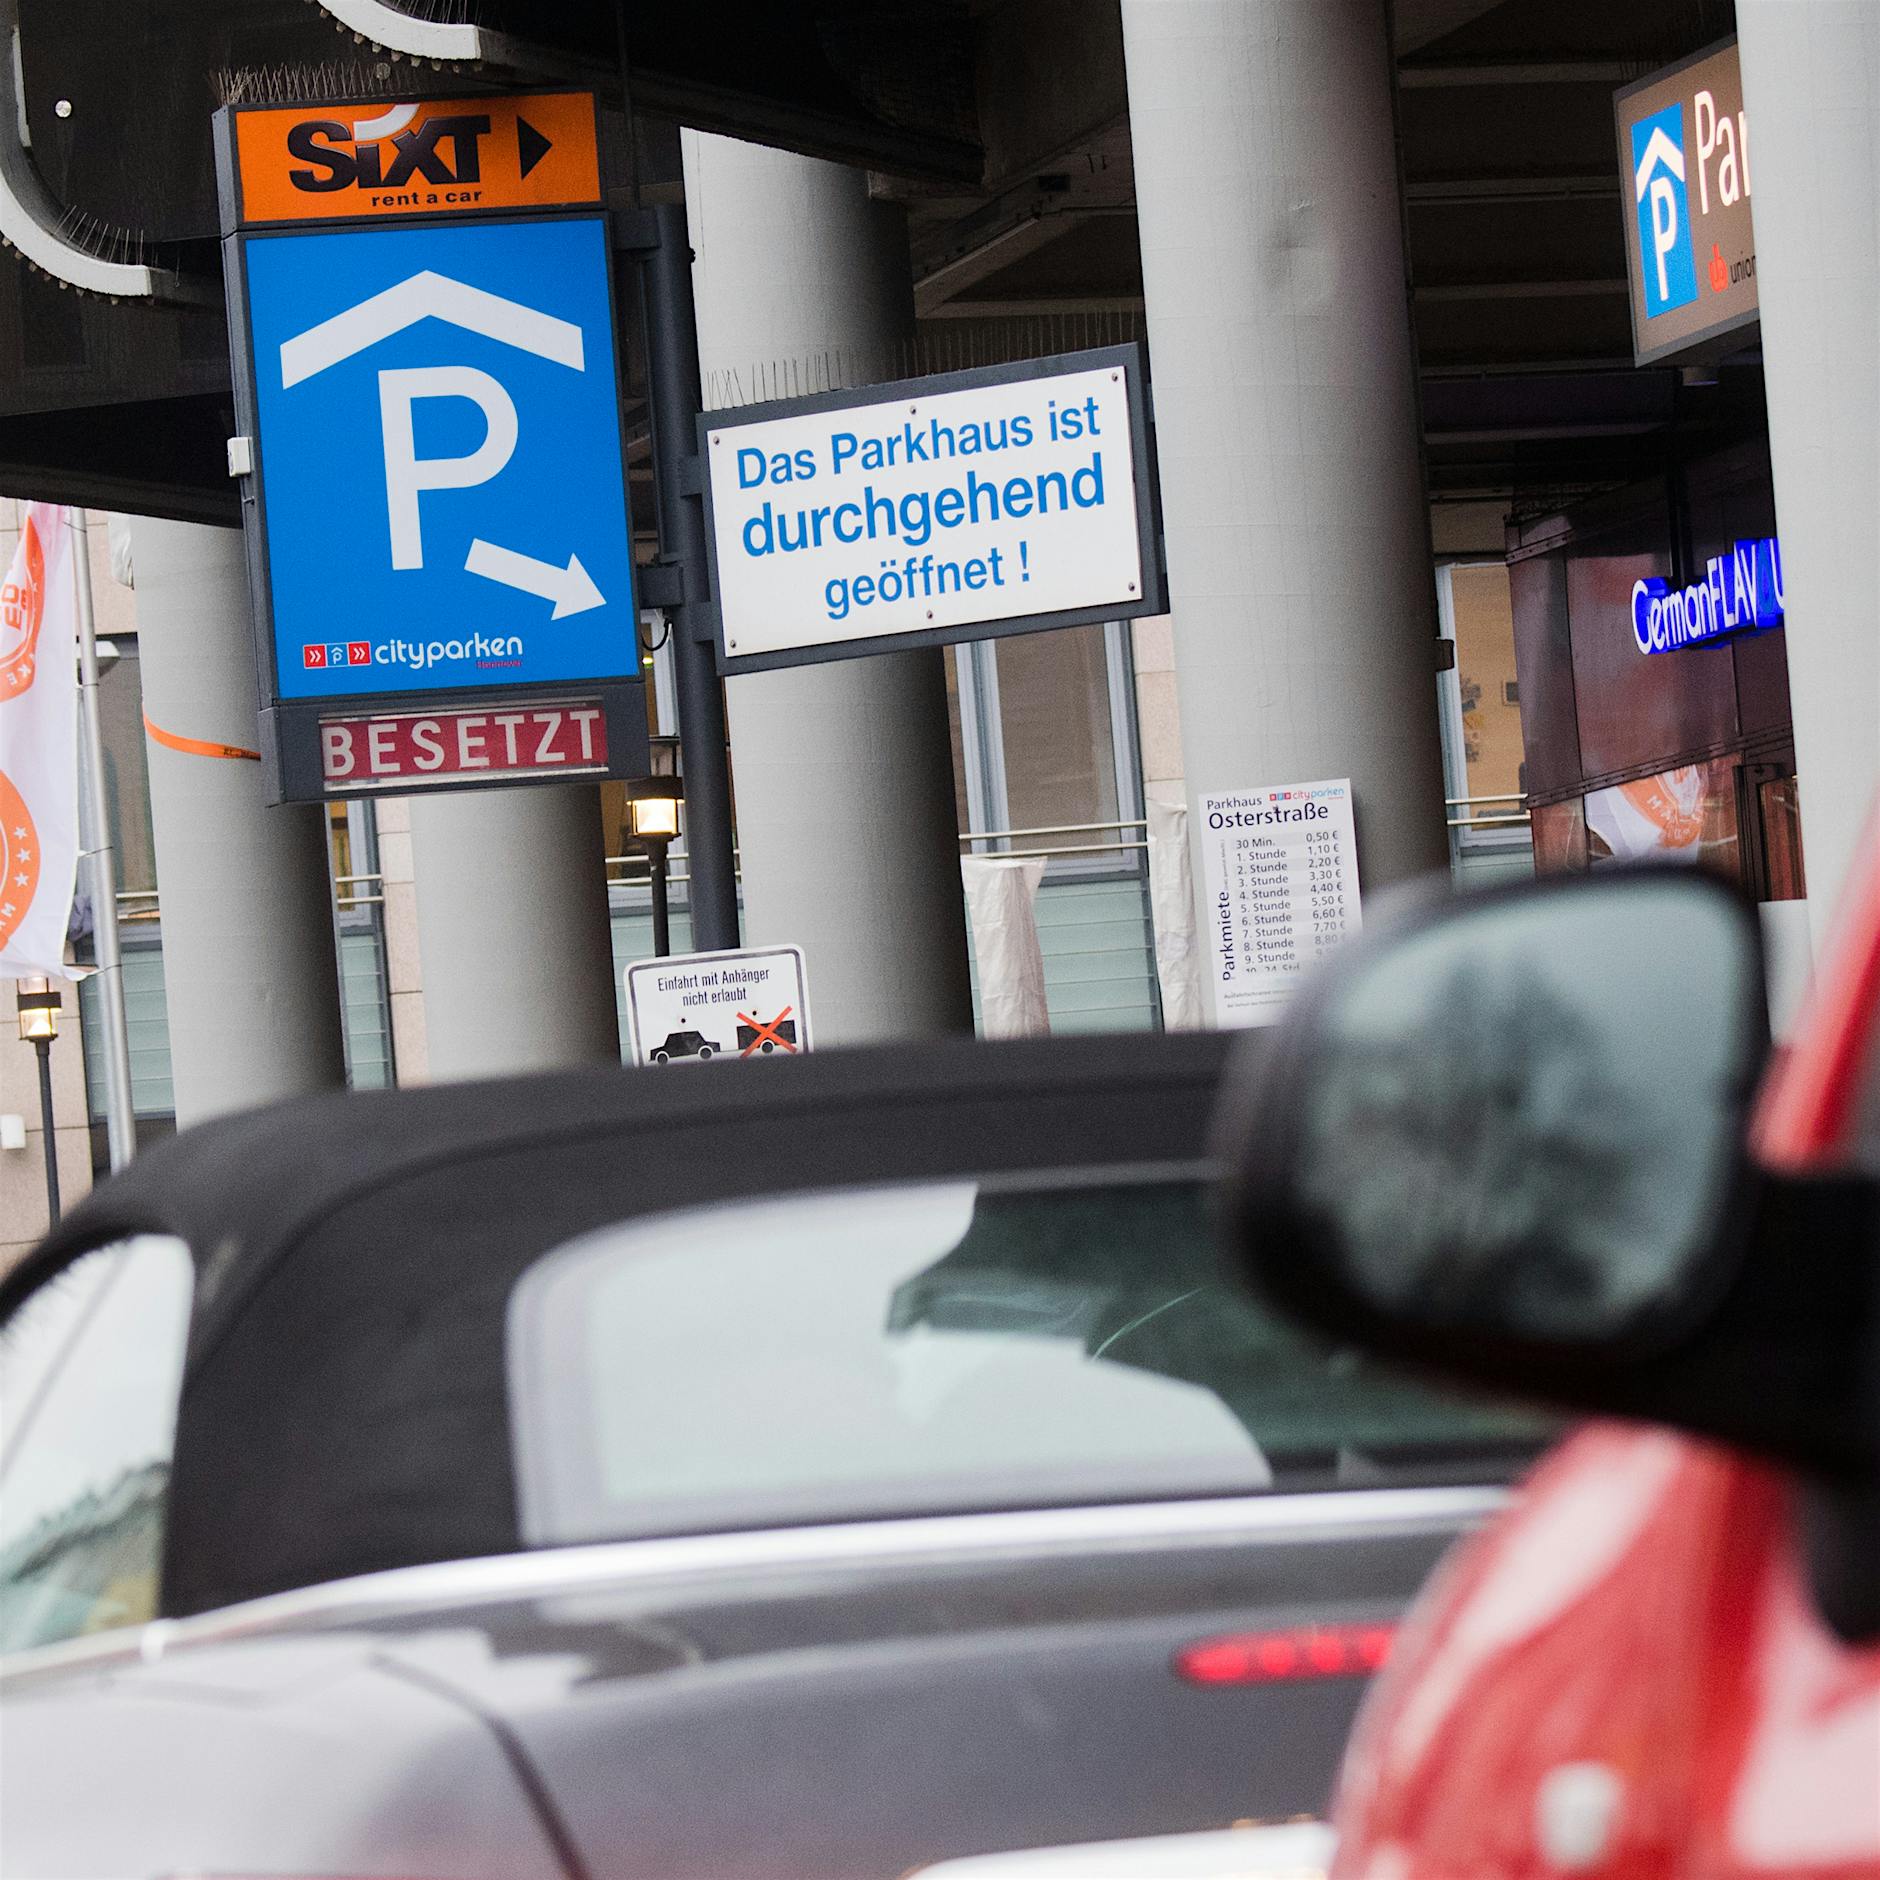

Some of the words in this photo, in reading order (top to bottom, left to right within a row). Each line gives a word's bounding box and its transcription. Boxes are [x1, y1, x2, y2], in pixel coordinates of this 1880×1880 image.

[372, 192, 419, 206] rent
[427, 194, 438, 204] a
[445, 190, 482, 203] car
[736, 447, 816, 489] Das
[831, 414, 1033, 475] Parkhaus
[1048, 396, 1101, 442] ist
[378, 366, 518, 570] P
[742, 451, 1105, 557] durchgehend
[824, 547, 1005, 620] geöffnet
[1019, 541, 1030, 582] !
[375, 632, 523, 670] cityparken
[321, 710, 600, 777] BESETZT
[1207, 796, 1262, 810] Parkhaus
[1209, 802, 1328, 829] Osterstraße
[1236, 840, 1248, 849] 30
[1252, 837, 1275, 848] Min.
[1306, 832, 1329, 843] 0,50
[1249, 849, 1286, 861] Stunde
[1308, 844, 1330, 856] 1,10
[1250, 862, 1287, 874] Stunde
[1308, 857, 1331, 868] 2,20
[1251, 874, 1288, 886] Stunde
[1310, 870, 1332, 882] 3,30
[1252, 888, 1290, 899] Stunde
[1310, 883, 1333, 894] 4,40
[1253, 900, 1291, 912] Stunde
[1312, 896, 1334, 906] 5,50
[1254, 913, 1292, 925] Stunde
[1312, 908, 1336, 920] 6,60
[1218, 892, 1235, 980] Parkmiete
[1256, 926, 1293, 938] Stunde
[1314, 922, 1336, 932] 7,70
[1256, 938, 1294, 950] Stunde
[1258, 952, 1295, 963] Stunde
[658, 974, 698, 992] Einfahrt
[702, 971, 718, 987] mit
[722, 968, 770, 984] Anhänger
[683, 991, 708, 1006] nicht
[712, 988, 747, 1003] erlaubt
